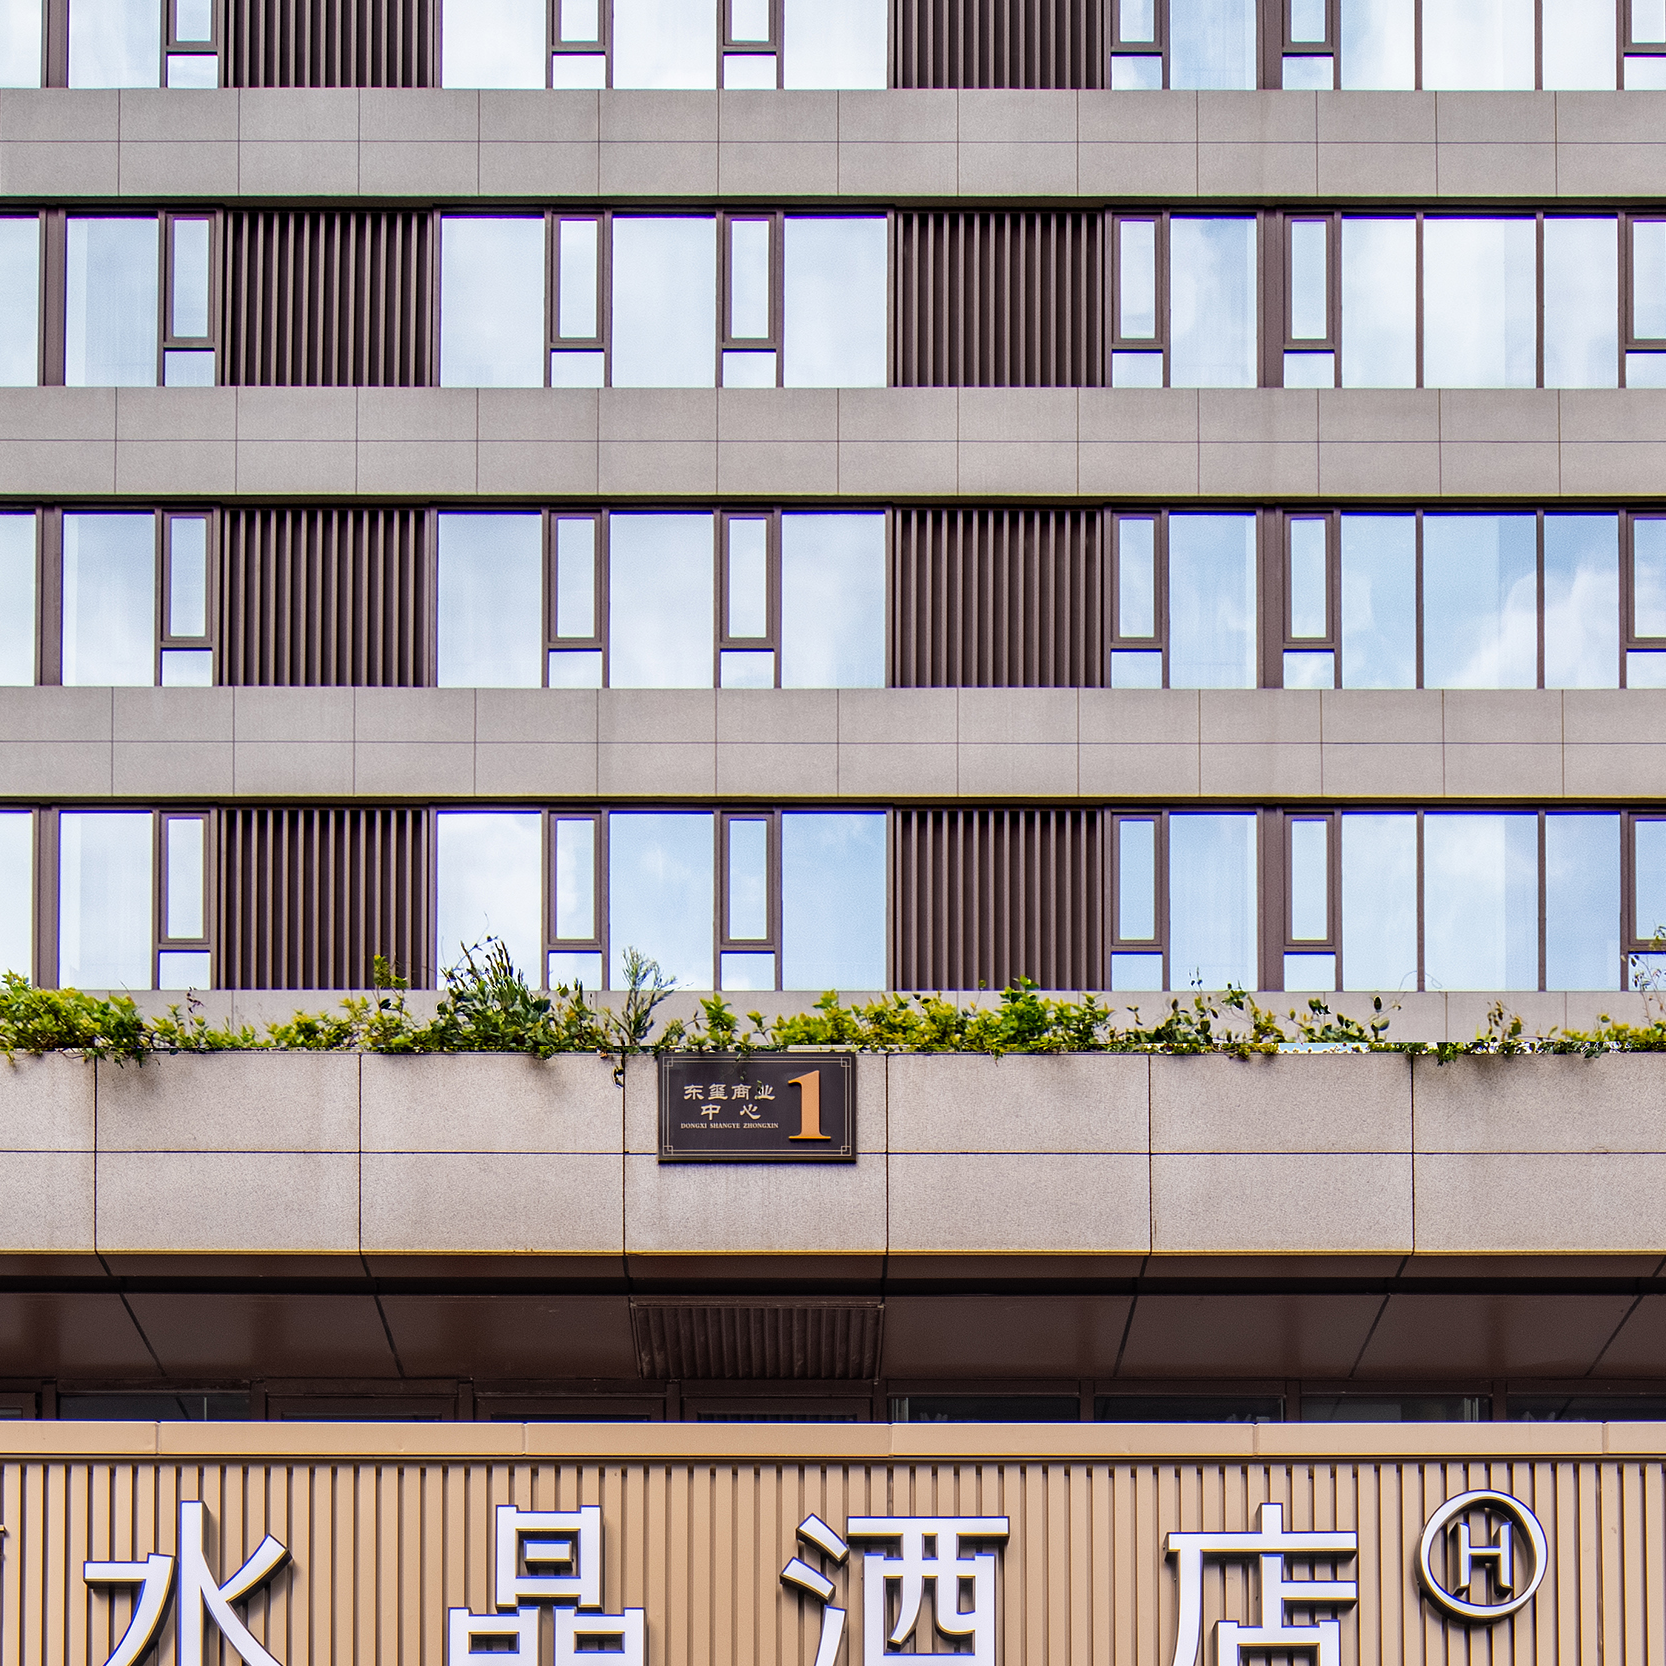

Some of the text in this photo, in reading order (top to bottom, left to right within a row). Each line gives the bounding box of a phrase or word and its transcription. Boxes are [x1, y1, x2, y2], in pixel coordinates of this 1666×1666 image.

[683, 1083, 776, 1101] 东玺商业
[699, 1102, 762, 1121] 中心
[787, 1069, 832, 1141] 1
